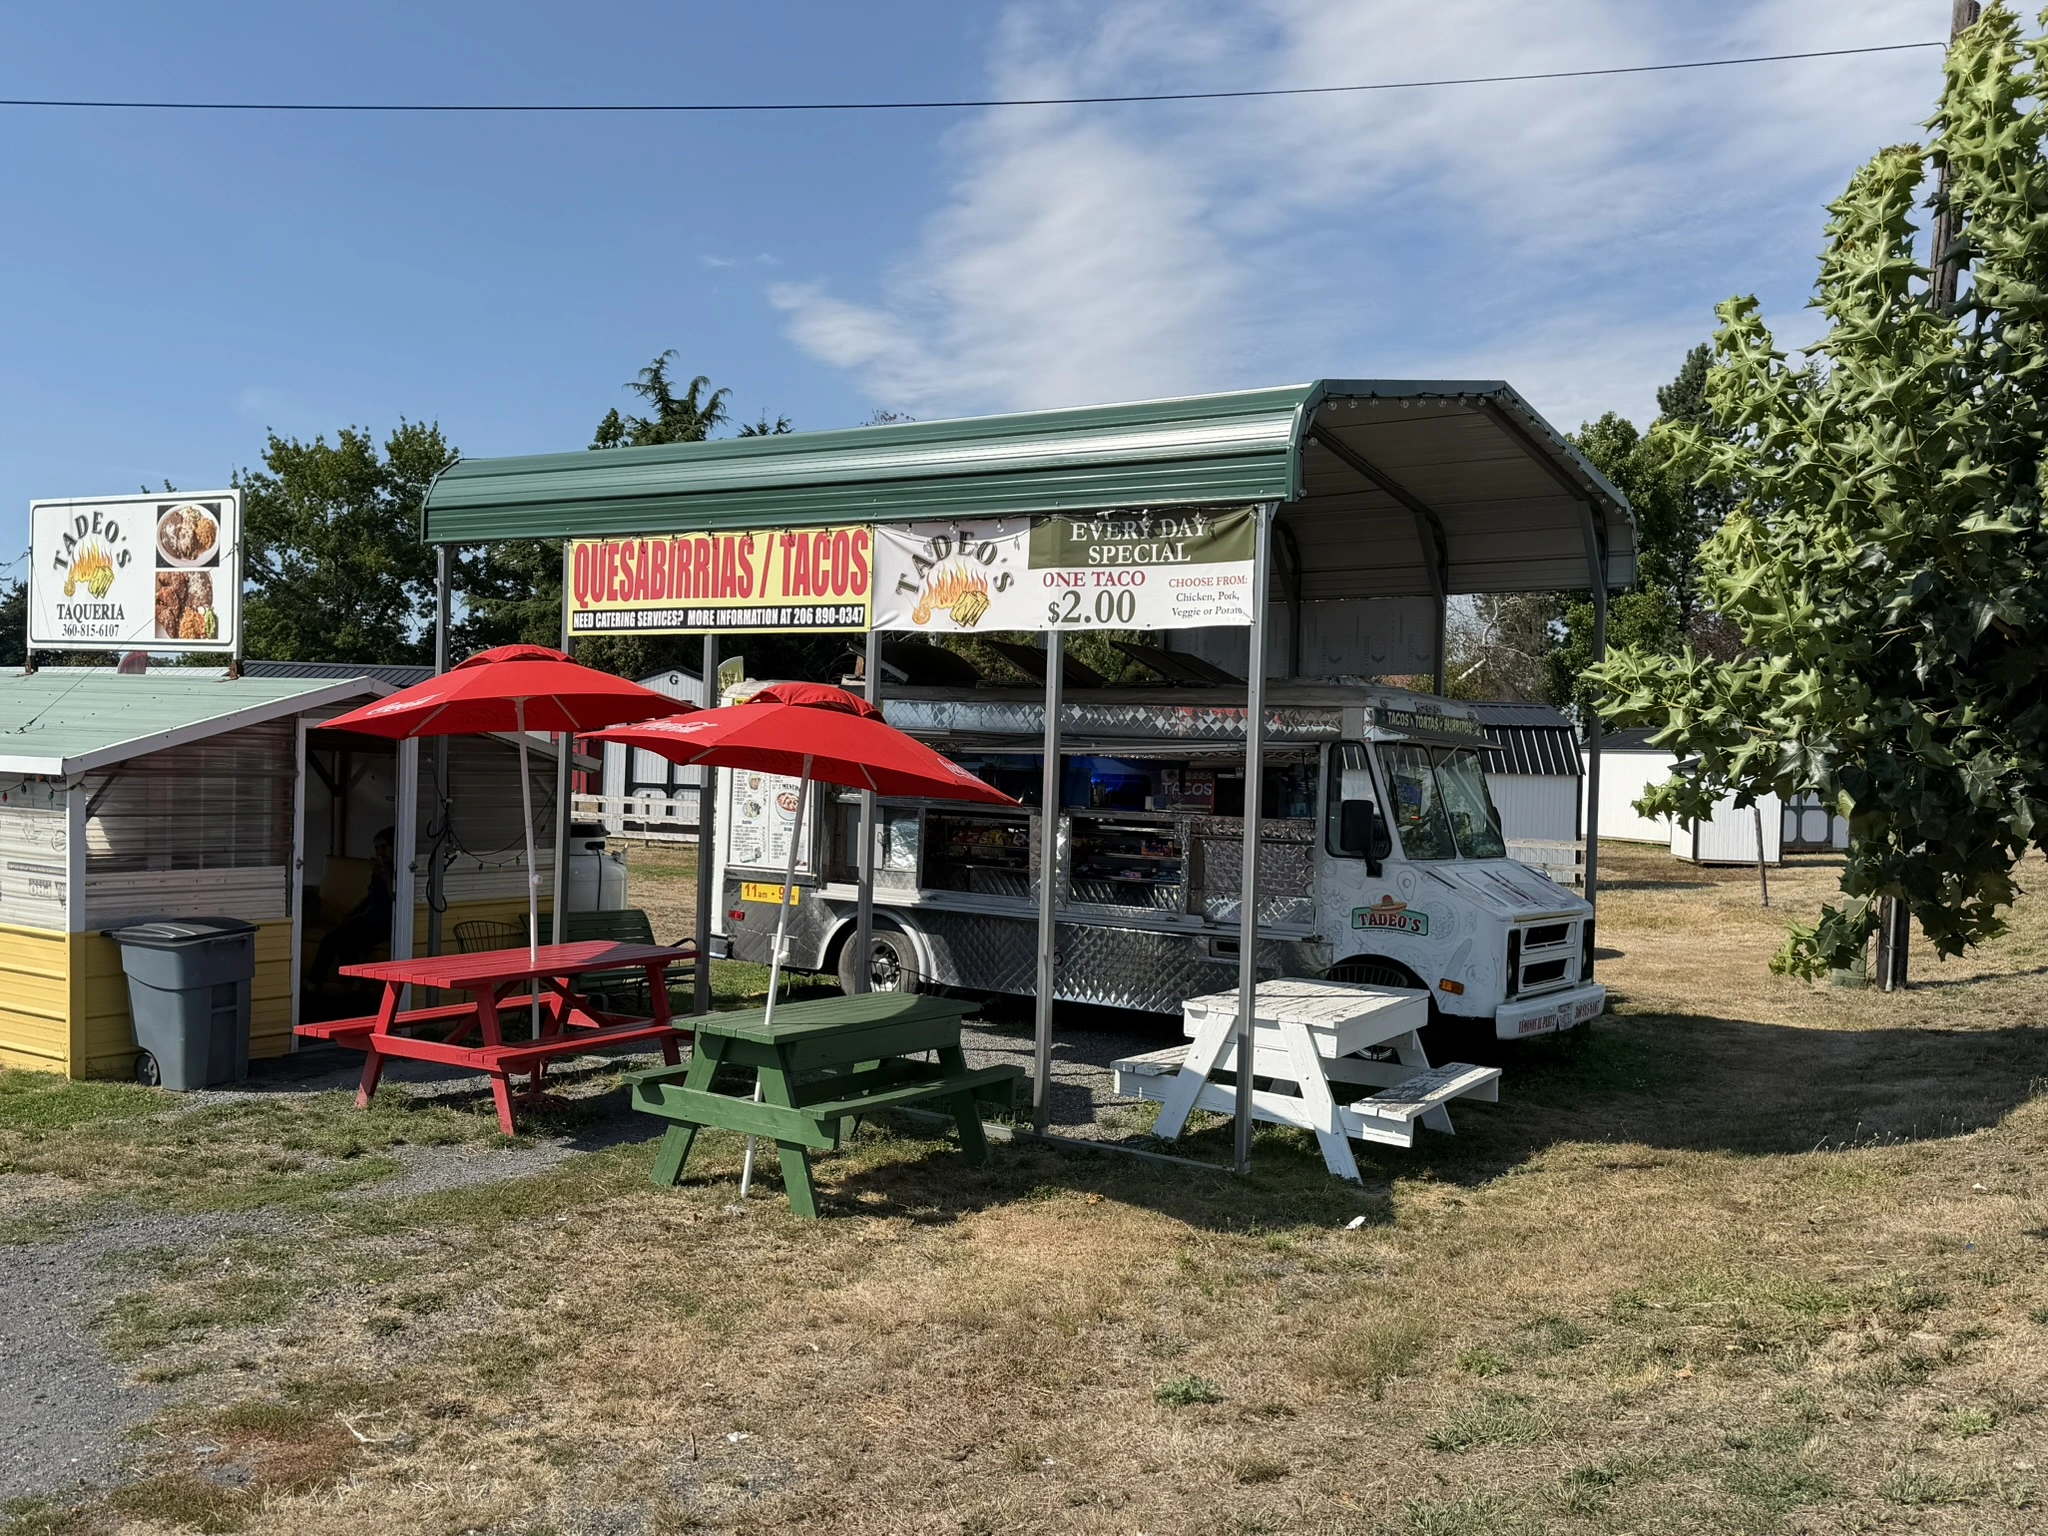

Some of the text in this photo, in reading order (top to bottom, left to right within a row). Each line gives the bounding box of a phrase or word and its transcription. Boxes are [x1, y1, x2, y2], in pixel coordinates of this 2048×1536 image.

[1070, 516, 1208, 542] EVERY DAY
[53, 510, 132, 572] TADEO'S
[895, 530, 1015, 595] TADEO'S
[1088, 542, 1191, 565] SPECIAL
[573, 536, 754, 608] QUESABIRRIAS
[780, 529, 868, 597] TACOS
[1043, 570, 1146, 588] ONE TACO
[1168, 575, 1248, 588] CHOOSE FROM:
[1048, 588, 1136, 625] $2.00
[1176, 590, 1240, 602] Chicken, Pork,
[57, 603, 125, 624] TAQUERIA
[573, 606, 864, 628] NEED CATERING SERVICES? MORE INFORMATION AT 206 890-0347
[1172, 607, 1202, 619] Veggie
[1215, 605, 1243, 615] Potato
[61, 624, 120, 637] 360-815-6107
[669, 675, 678, 685] G
[1388, 711, 1473, 733] TACOS TORTAS BURRITOS
[1185, 771, 1212, 780] BIRRIA
[1358, 913, 1421, 932] TADEO'S
